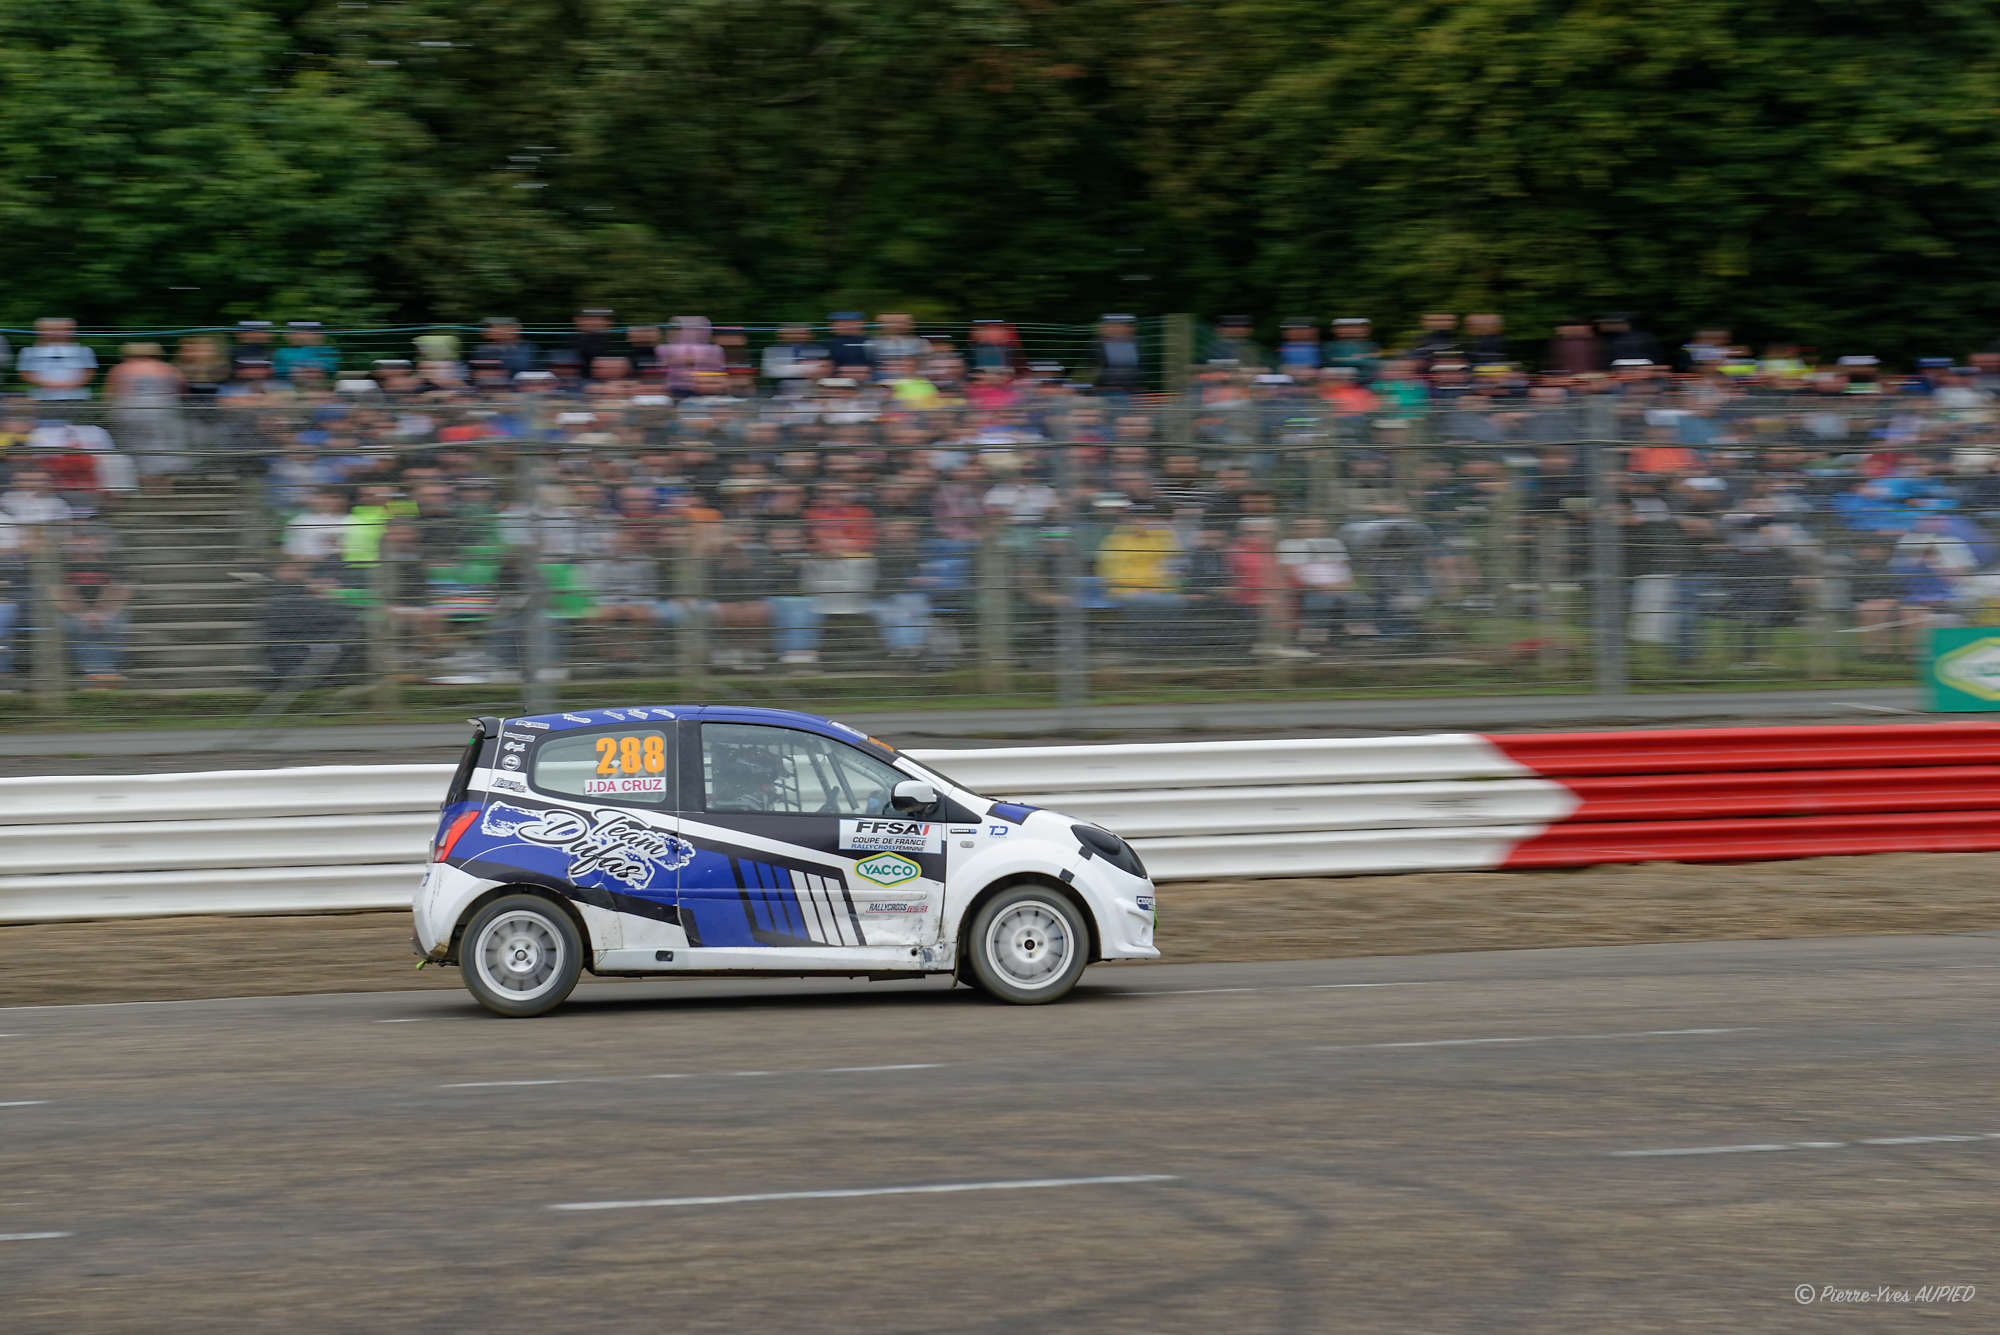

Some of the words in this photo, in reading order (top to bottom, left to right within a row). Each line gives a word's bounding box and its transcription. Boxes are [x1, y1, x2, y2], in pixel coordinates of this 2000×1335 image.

[596, 736, 665, 774] 288
[586, 780, 616, 793] J.DA
[621, 779, 663, 792] CRUZ
[594, 808, 666, 856] Team
[856, 821, 921, 835] FFSA
[852, 836, 880, 844] COUPE
[882, 837, 893, 845] DE
[894, 838, 926, 846] FRANCE
[863, 864, 913, 876] YACCO
